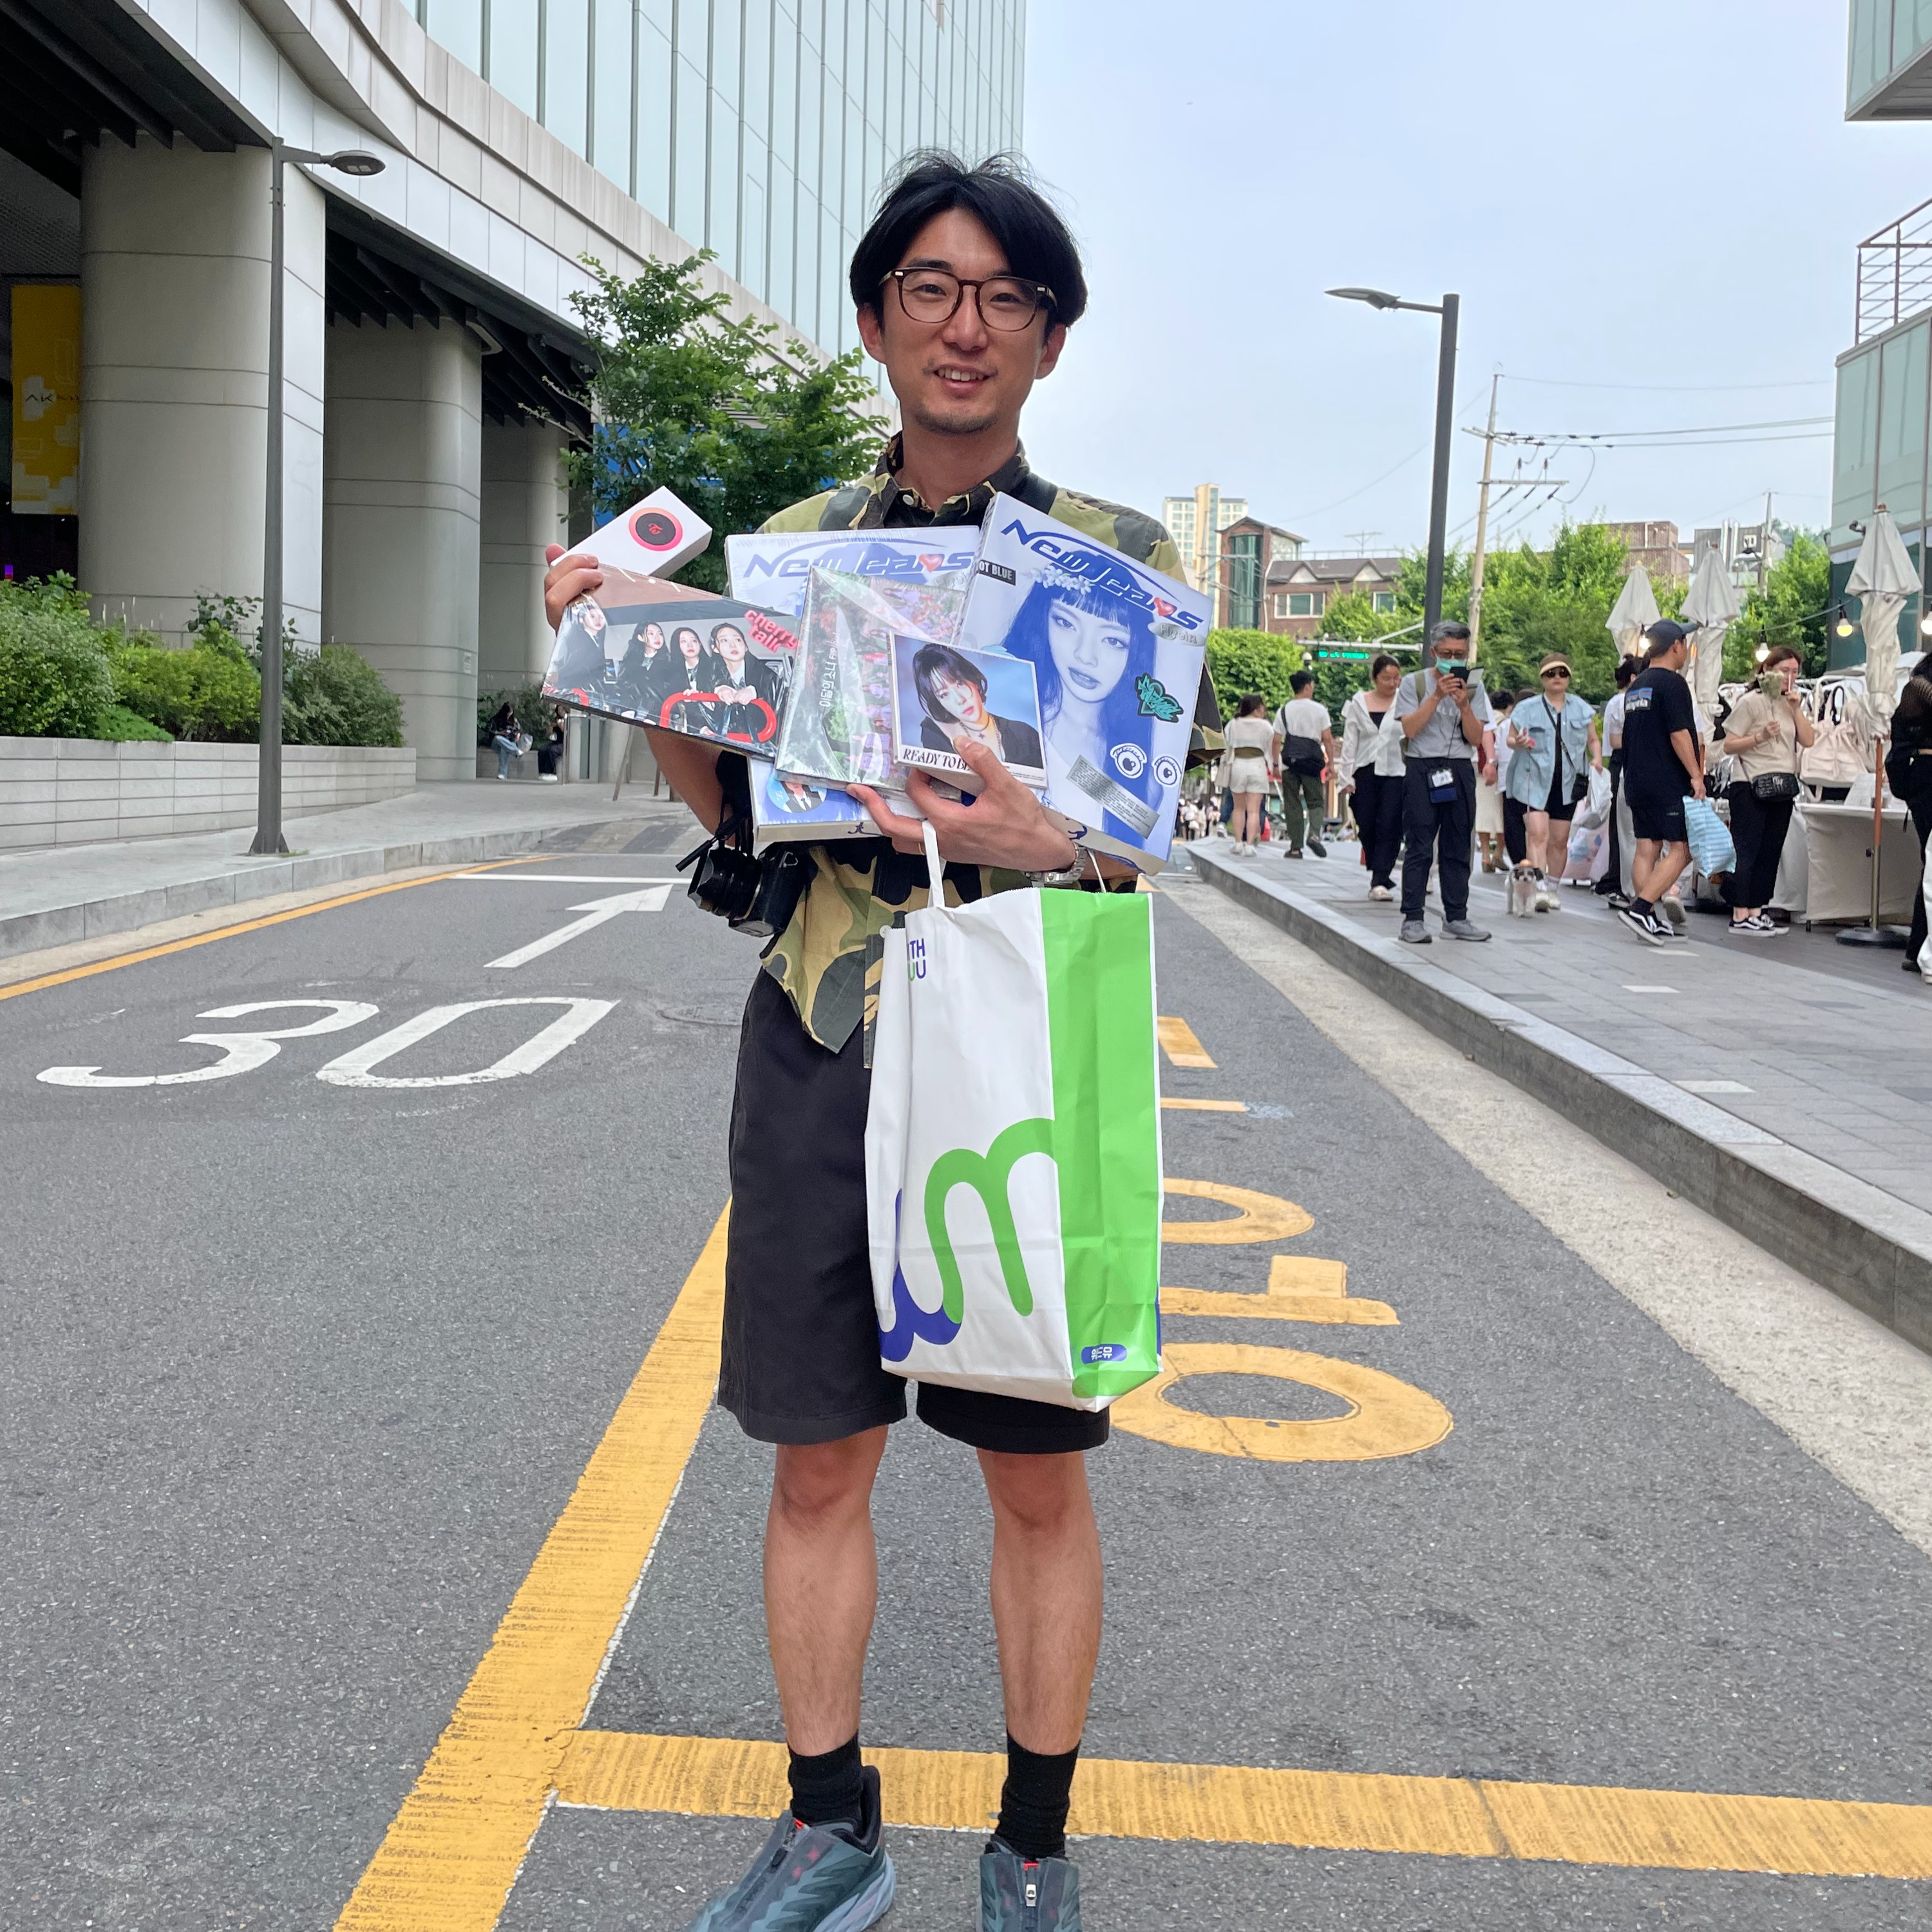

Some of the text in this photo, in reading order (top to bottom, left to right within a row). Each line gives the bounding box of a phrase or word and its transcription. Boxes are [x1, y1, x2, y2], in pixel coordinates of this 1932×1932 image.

[979, 560, 1012, 581] OT BLUE
[744, 609, 799, 650] cherry
[748, 624, 781, 654] talk
[823, 661, 837, 680] 소녀
[819, 680, 835, 707] 이달의
[903, 748, 941, 766] READY
[942, 755, 956, 768] TO
[36, 997, 620, 1087] 30
